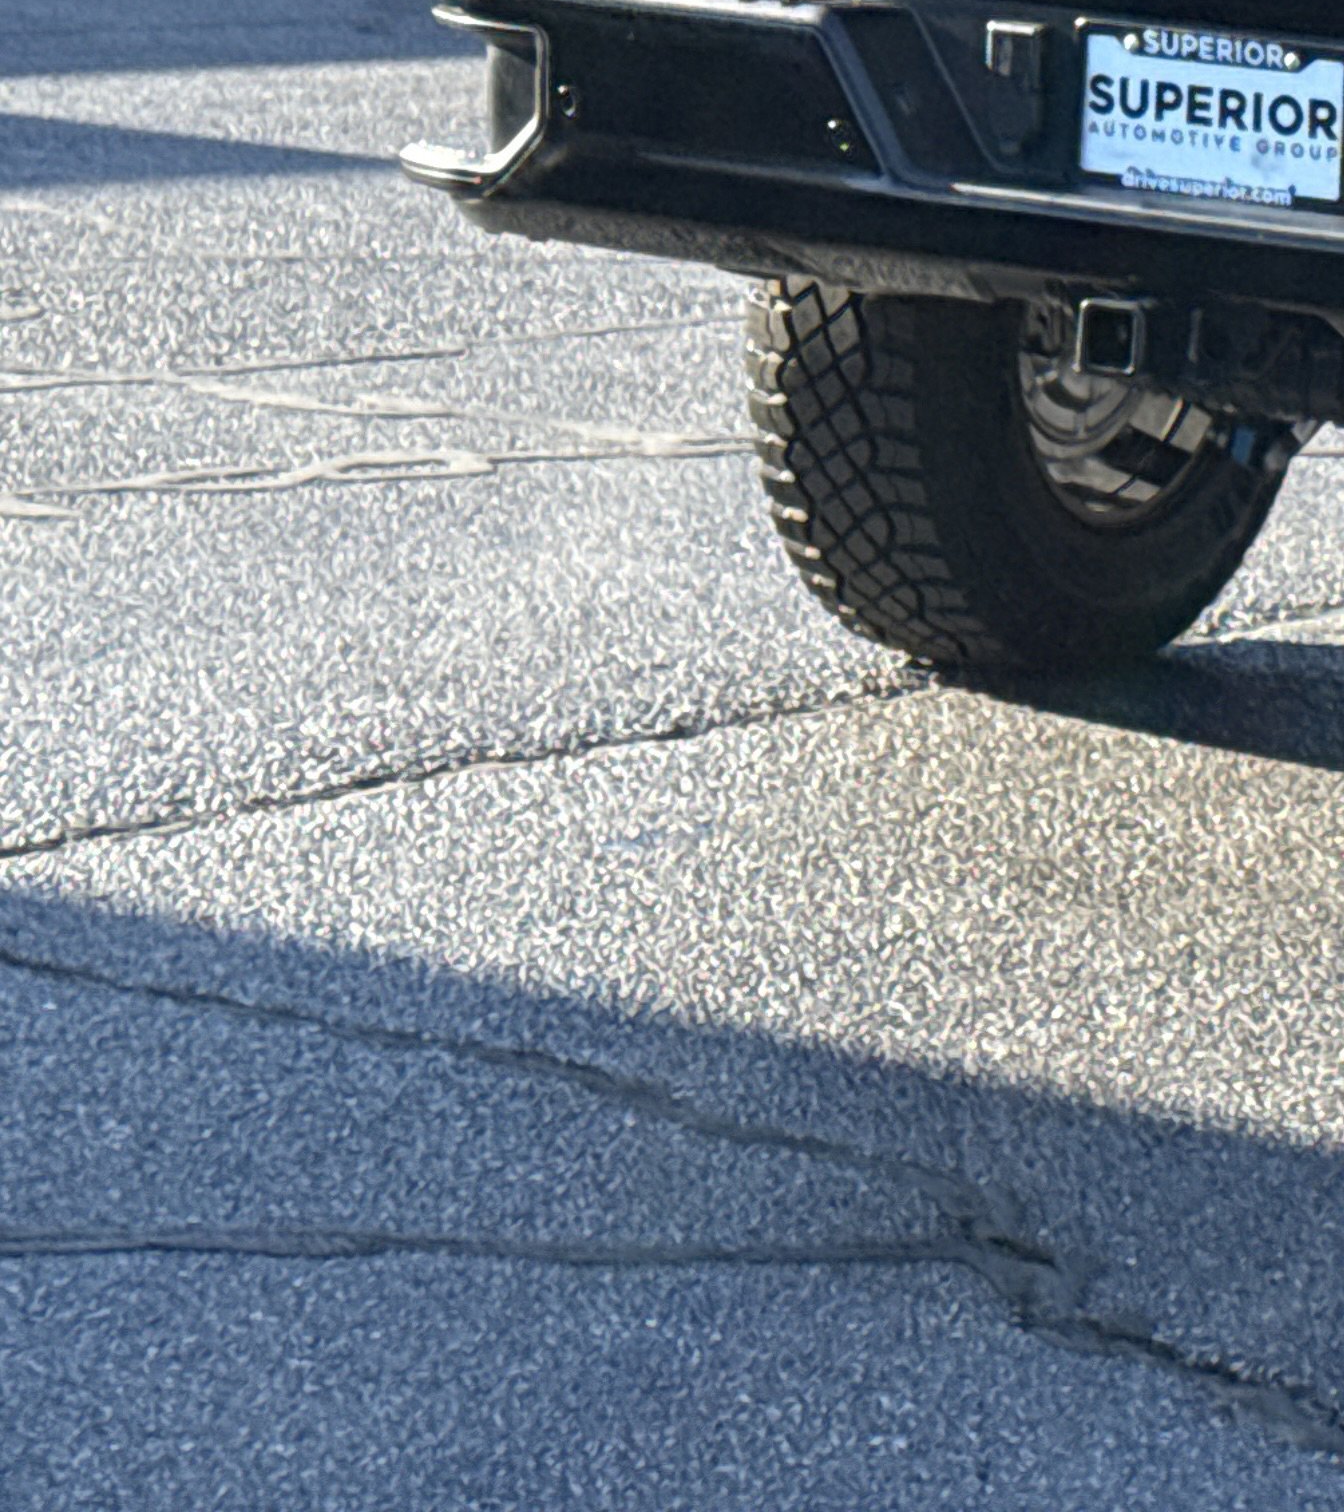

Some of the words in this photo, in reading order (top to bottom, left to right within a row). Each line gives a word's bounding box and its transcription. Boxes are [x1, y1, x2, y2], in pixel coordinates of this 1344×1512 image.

[1142, 29, 1284, 69] SUPERIOR
[1088, 74, 1338, 140] SUPERIOR
[1088, 119, 1242, 153] AUTOMOTIVE
[1255, 138, 1338, 163] GROUP
